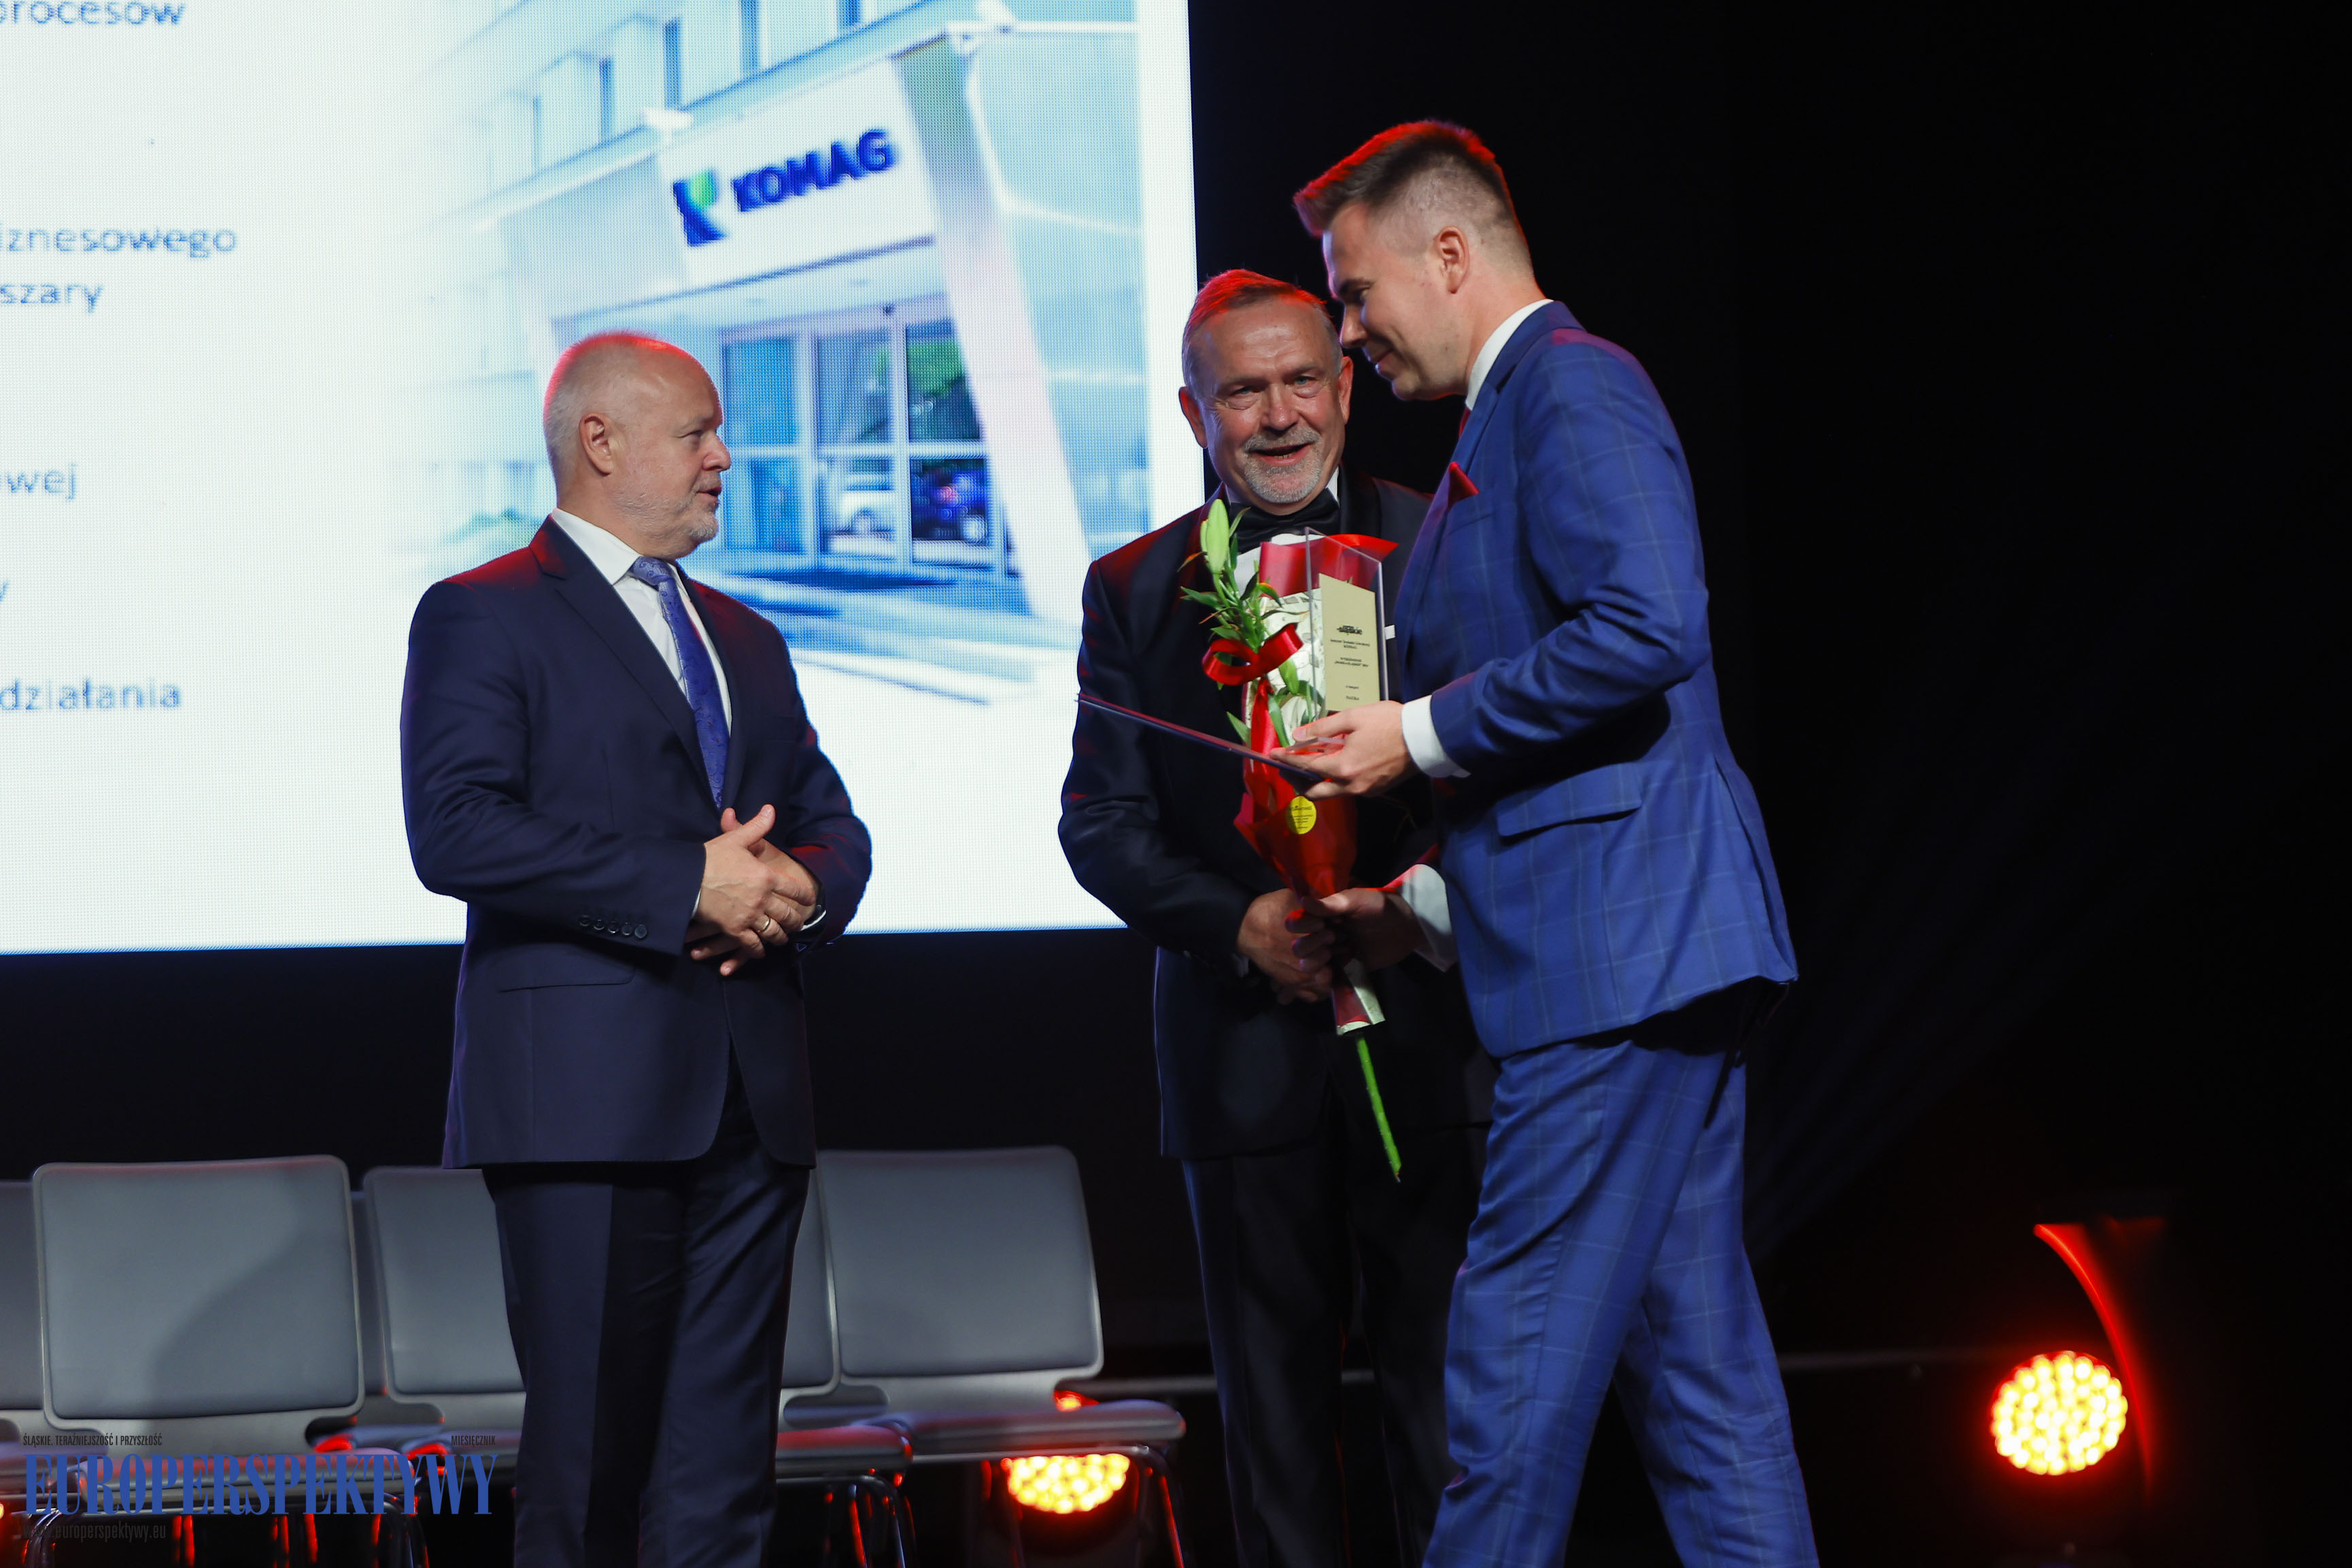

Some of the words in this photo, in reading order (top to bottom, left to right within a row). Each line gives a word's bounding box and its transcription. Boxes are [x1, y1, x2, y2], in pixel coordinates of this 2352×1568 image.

[731, 129, 898, 213] KOMAG
[0, 283, 103, 313] szary
[0, 463, 77, 502] wej
[0, 677, 182, 711] działania
